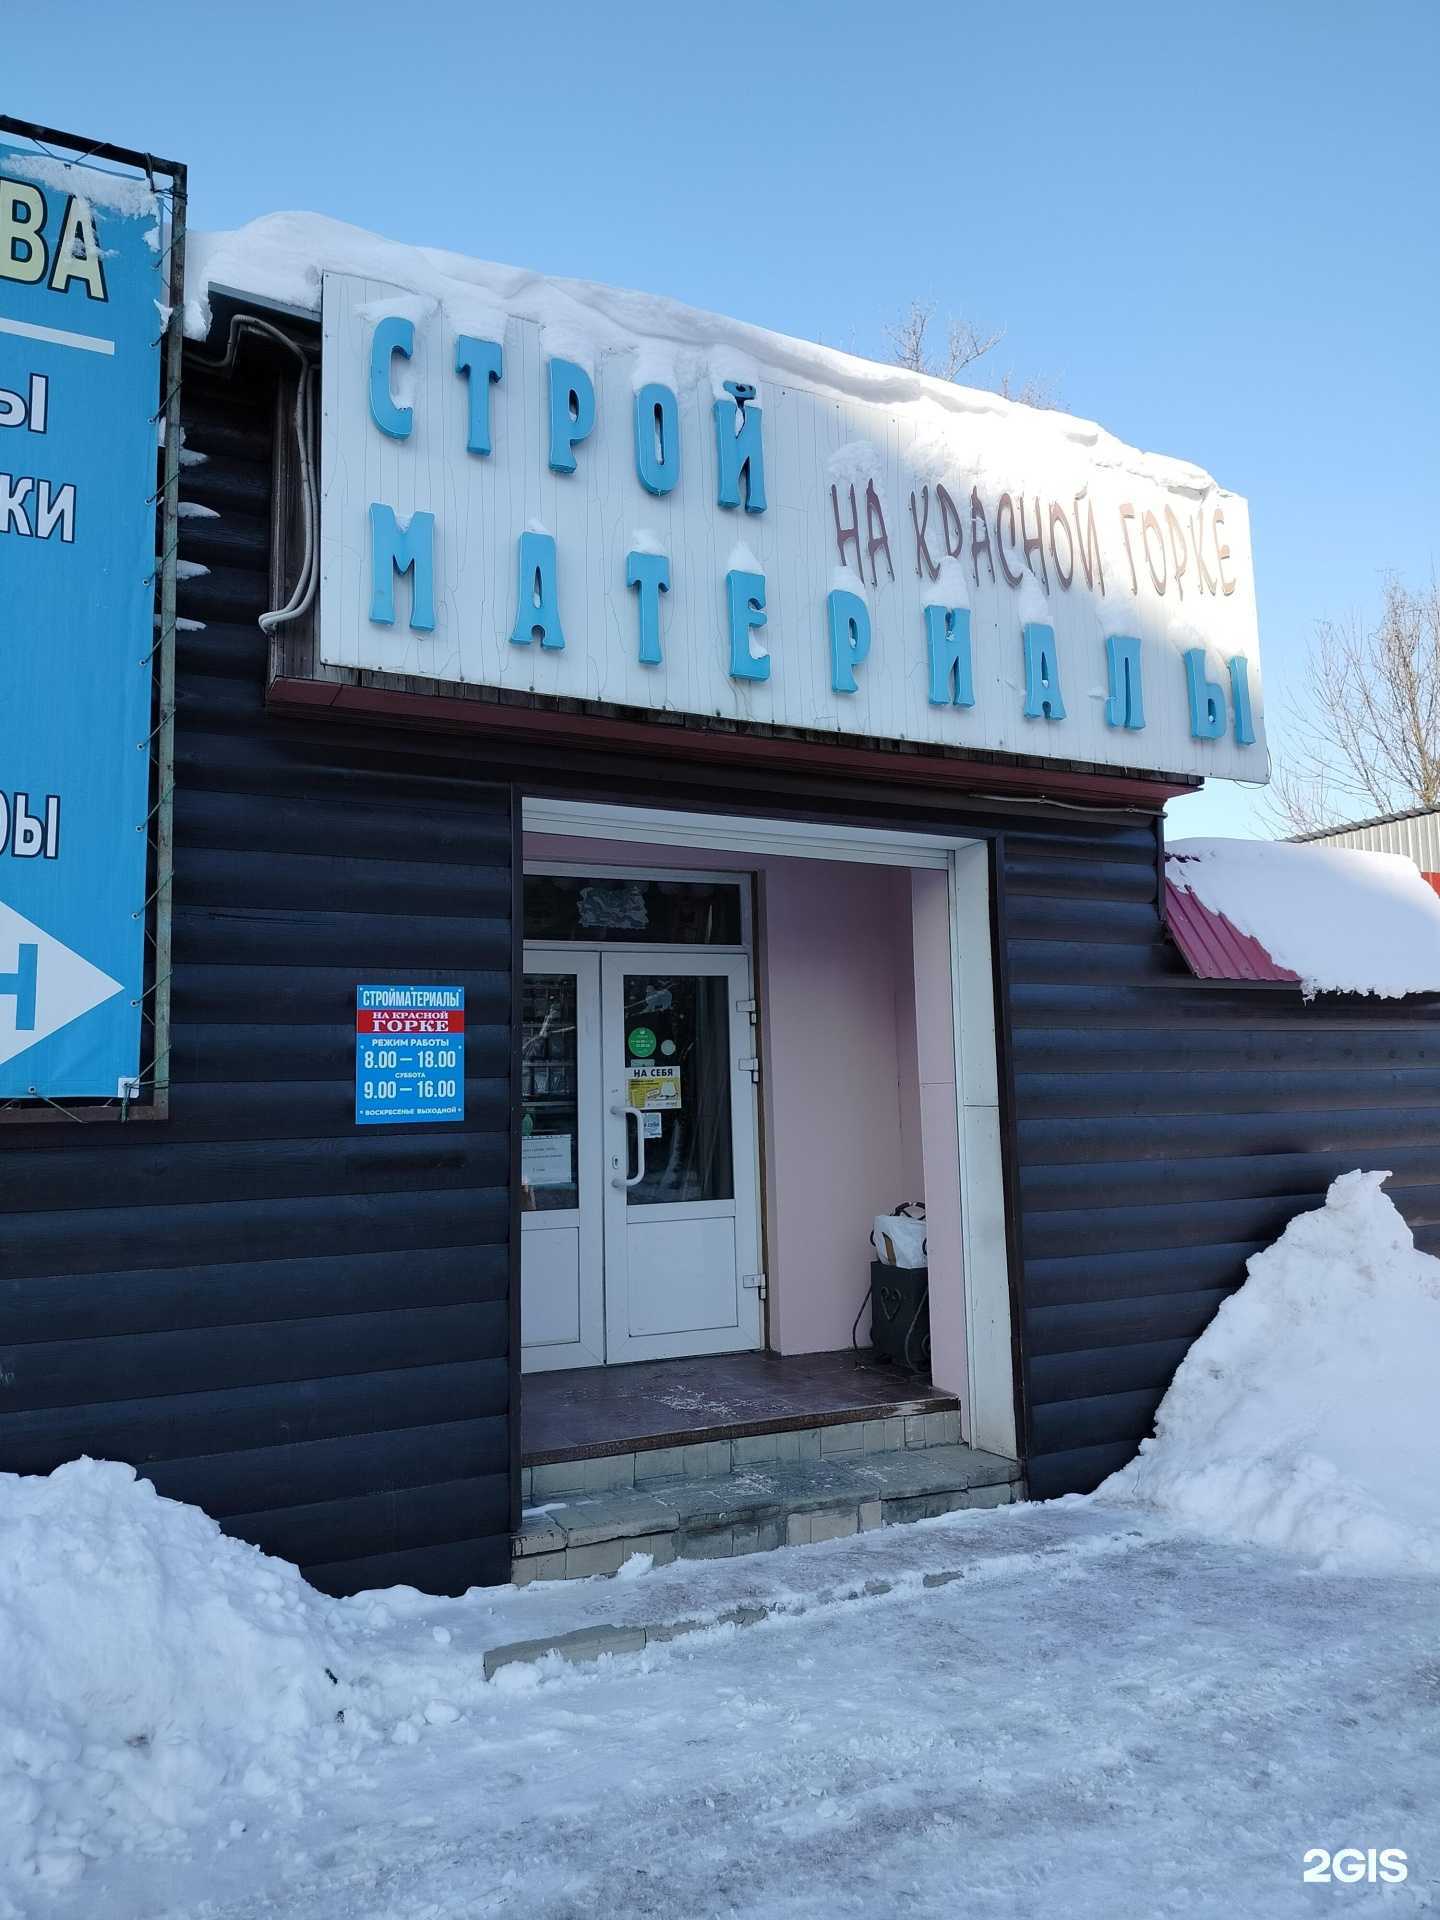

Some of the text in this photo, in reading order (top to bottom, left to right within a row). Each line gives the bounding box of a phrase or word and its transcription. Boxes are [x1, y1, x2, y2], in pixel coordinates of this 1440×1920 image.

[0, 176, 108, 303] ВА
[370, 316, 767, 513] СТРОЙ
[0, 472, 76, 543] КИ
[831, 478, 1237, 601] НА КРАСНОЙ ГОРКЕ
[369, 502, 1256, 745] МАТЕРИАЛЫ
[363, 989, 459, 1007] СТРОЙМАТЕРИАЛЫ
[372, 1010, 449, 1019] НА КРАСНОЙ
[372, 1020, 449, 1032] ГОРКЕ
[372, 1038, 449, 1047] РЕЖИМ РАБОТЫ
[364, 1051, 397, 1069] 8.00
[417, 1050, 456, 1068] 18.00
[633, 1068, 673, 1077] НА СЕБЯ
[364, 1081, 397, 1099] 9.00
[417, 1080, 456, 1098] 16.00
[417, 1106, 456, 1114] ВЫХОДНОЙ
